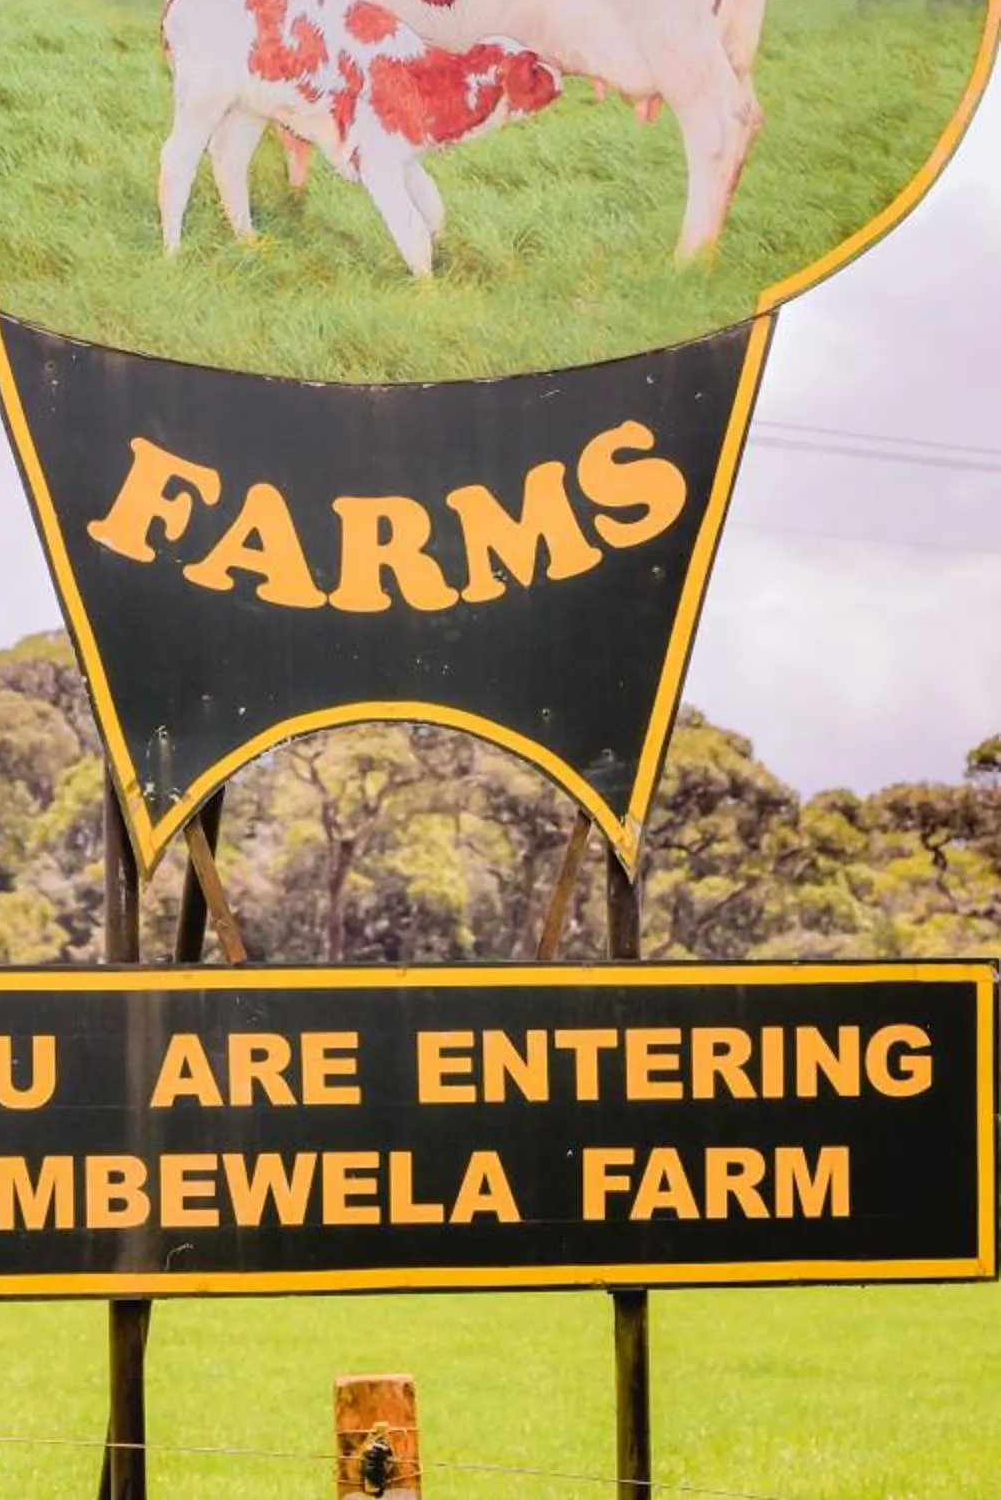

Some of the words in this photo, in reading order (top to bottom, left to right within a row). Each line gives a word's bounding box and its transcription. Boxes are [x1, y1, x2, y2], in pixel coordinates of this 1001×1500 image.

[87, 420, 687, 612] FARMS
[151, 1032, 361, 1108] ARE
[418, 1025, 932, 1104] ENTERING
[582, 1147, 850, 1220] FARM
